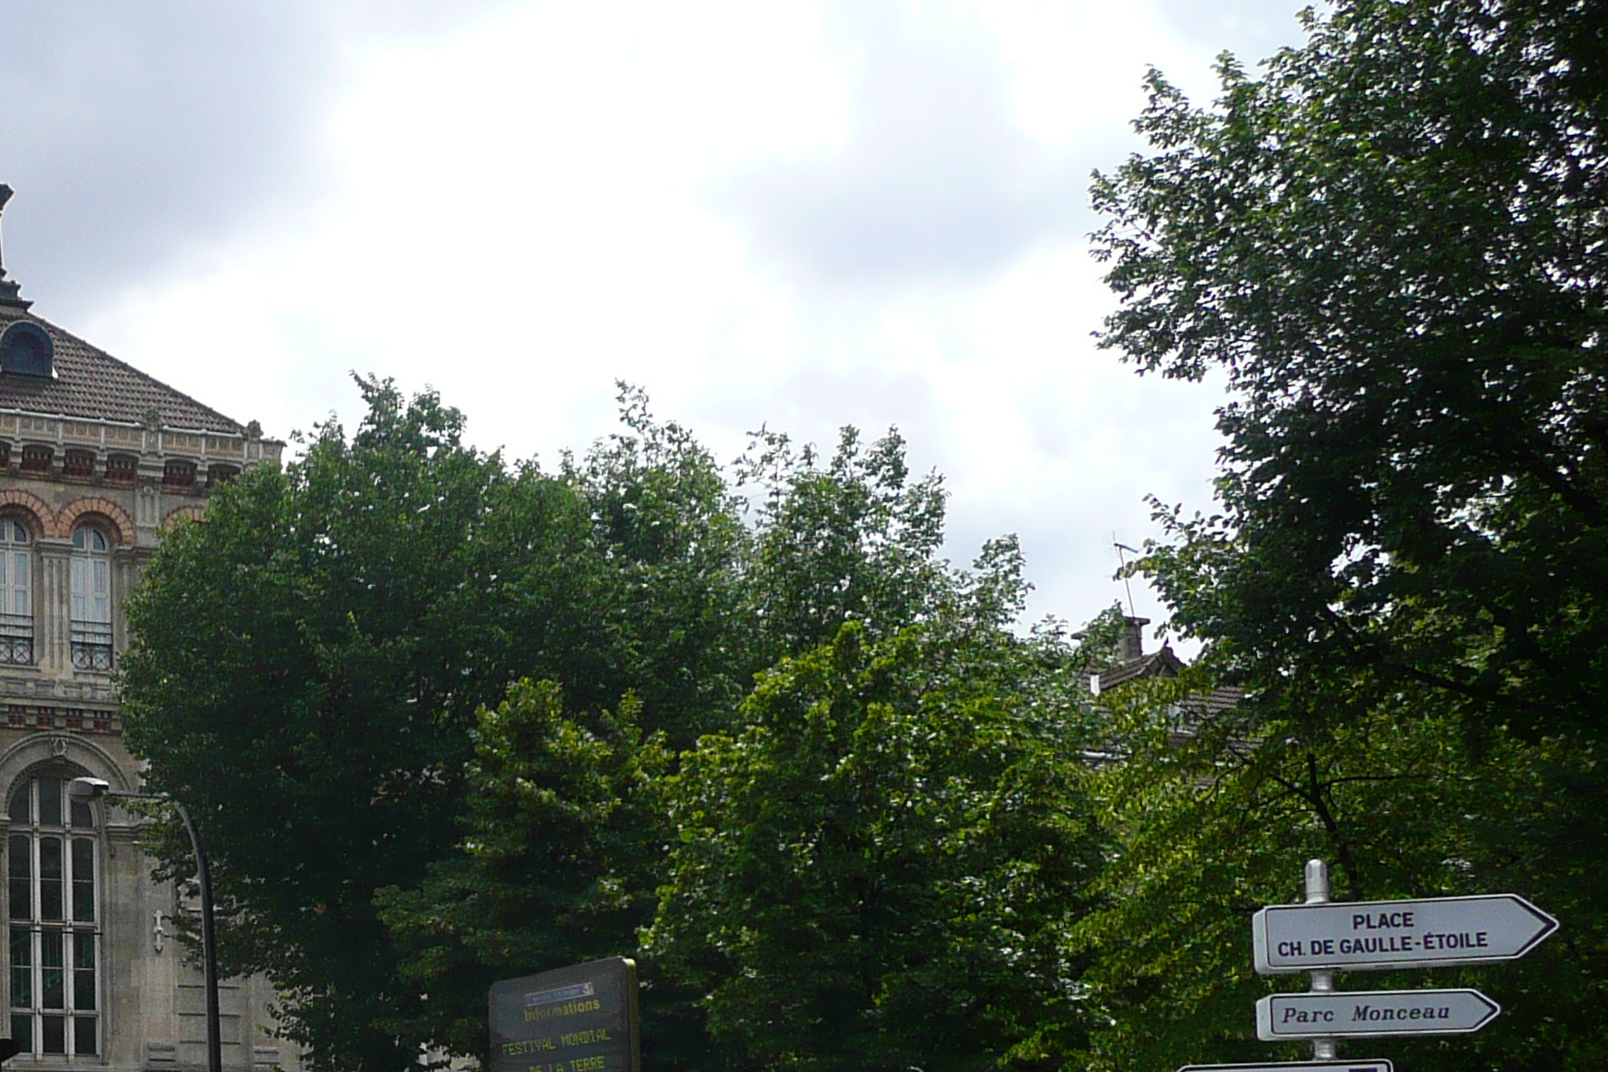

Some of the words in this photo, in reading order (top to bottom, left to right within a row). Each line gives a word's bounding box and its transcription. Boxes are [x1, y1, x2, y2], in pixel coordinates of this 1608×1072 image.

[1352, 912, 1415, 930] PLACE
[1277, 941, 1307, 957] CH.
[1310, 939, 1335, 955] DE
[524, 999, 601, 1022] Informations
[1281, 1007, 1335, 1024] Parc
[1350, 1004, 1451, 1022] Monceau
[502, 1037, 557, 1056] FESTIVAL
[561, 1028, 612, 1048] MONDIAL
[569, 1055, 605, 1072] TERRE
